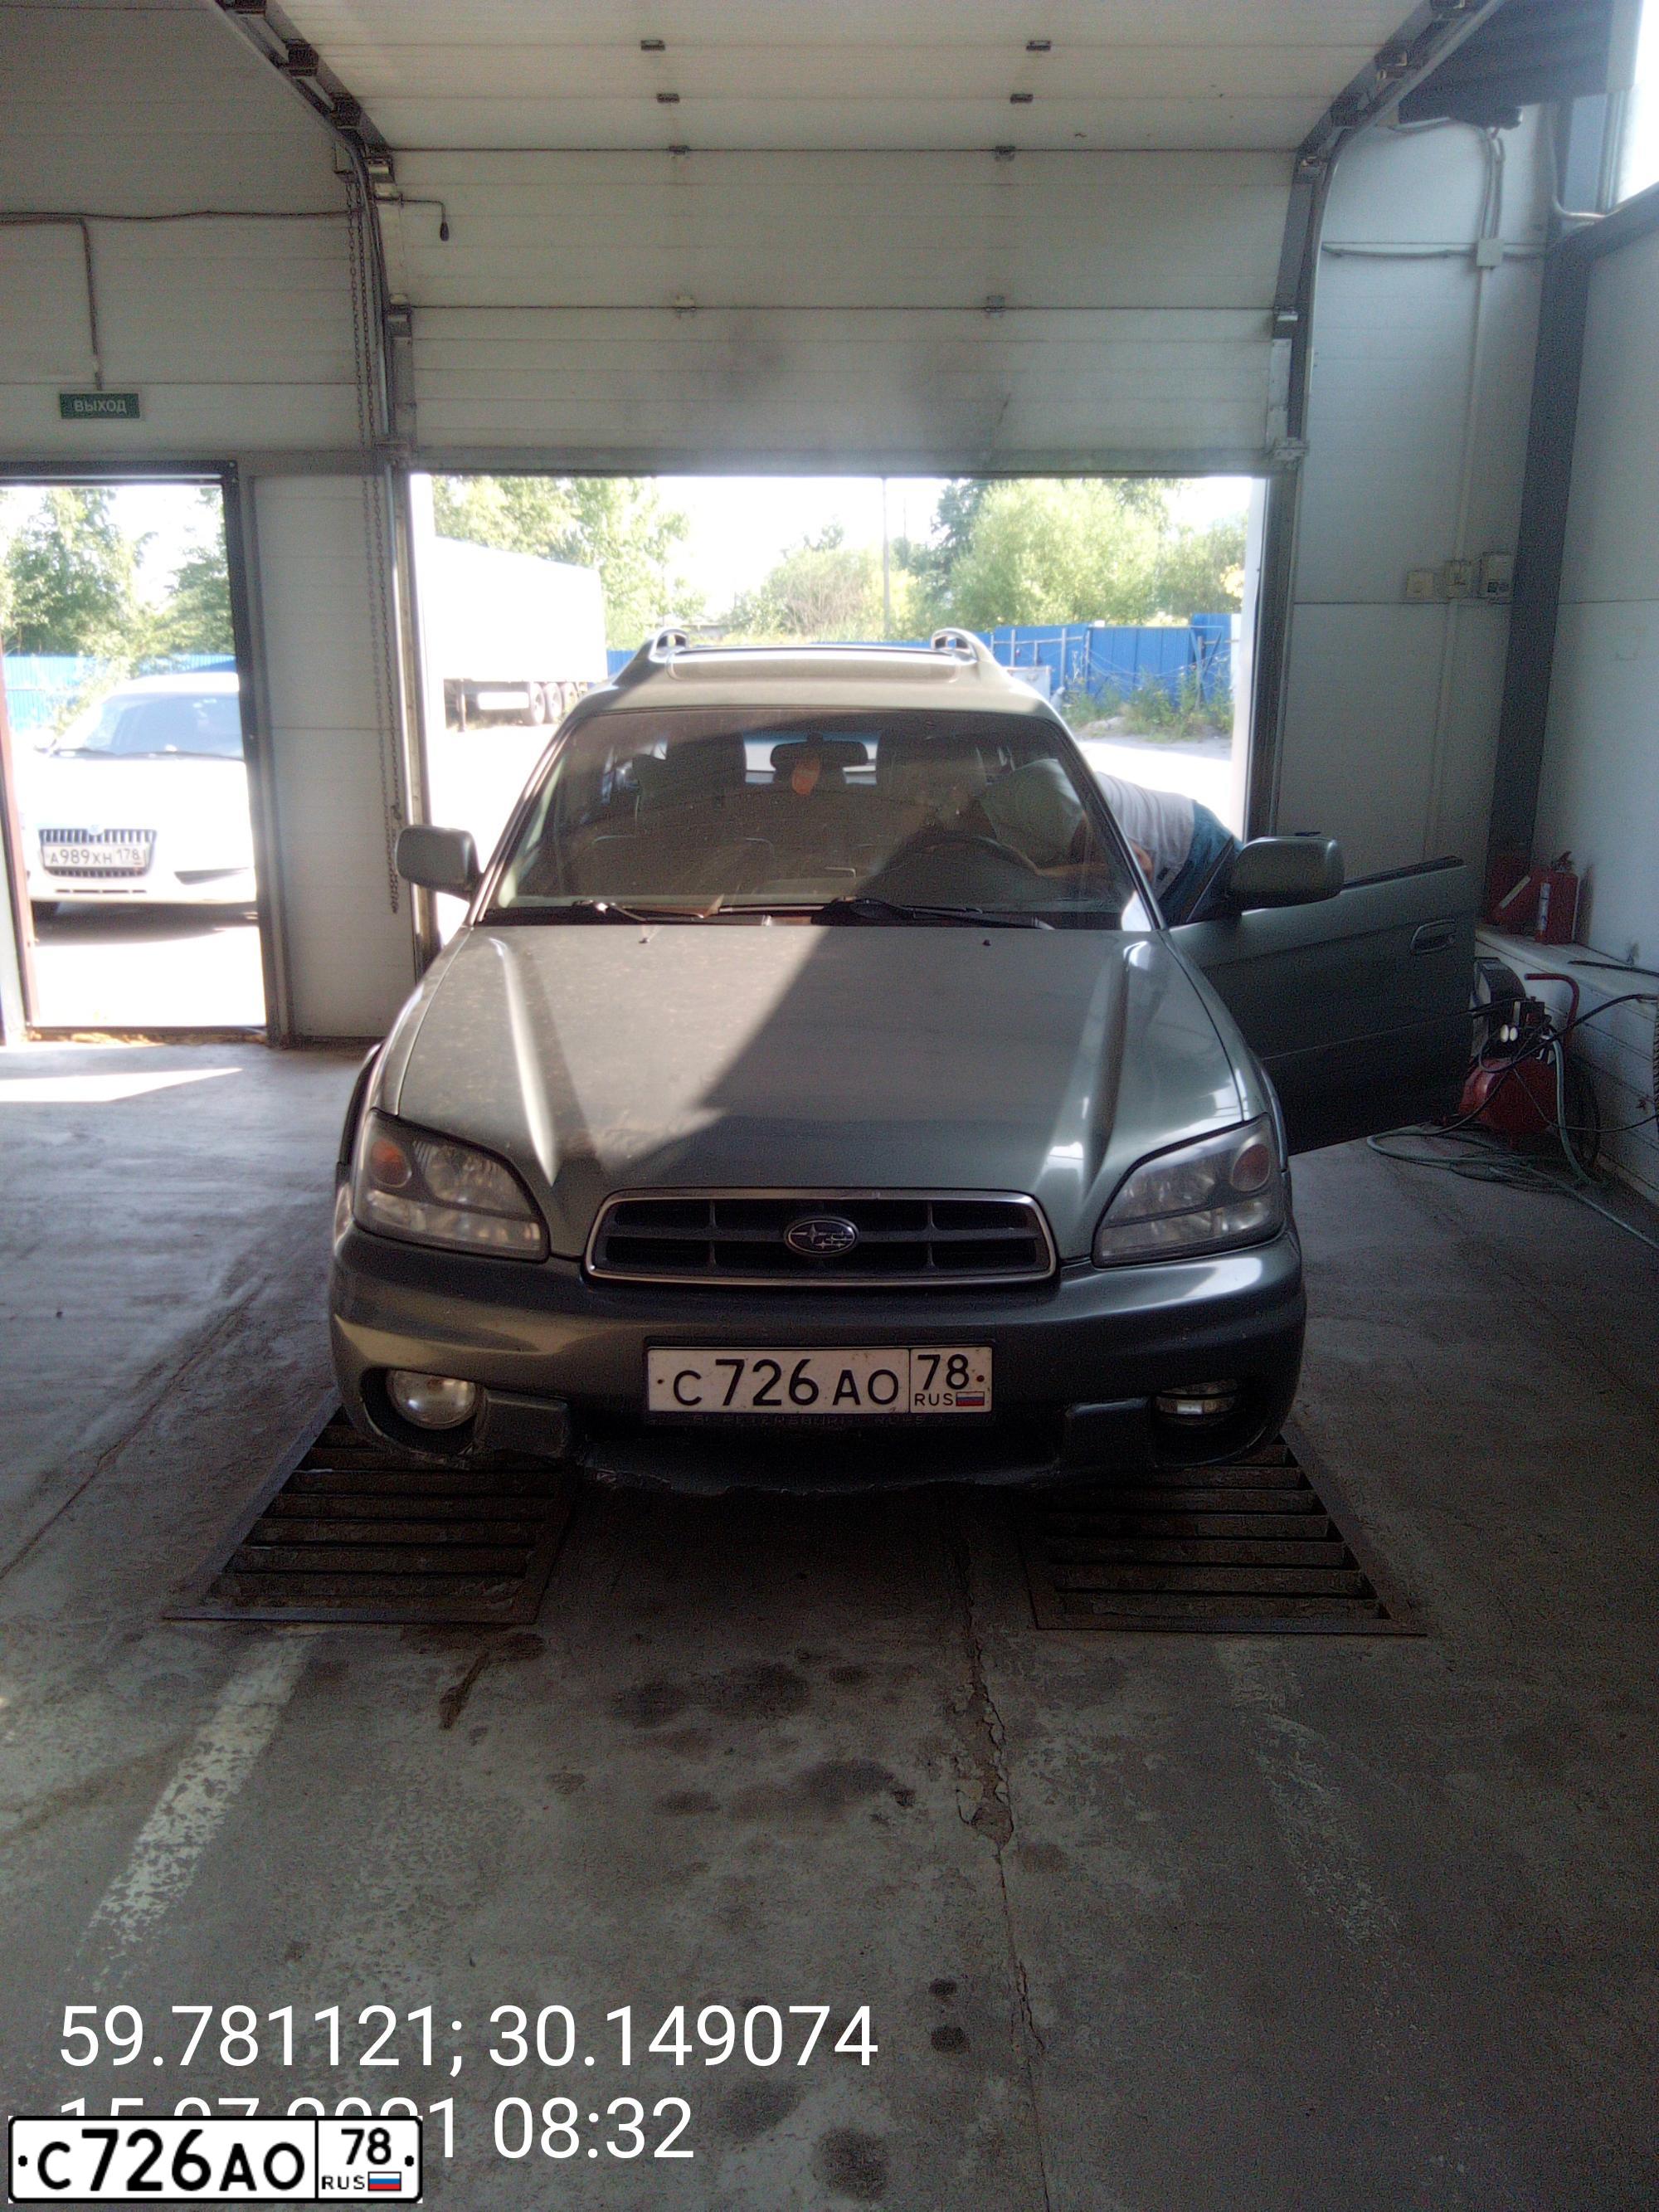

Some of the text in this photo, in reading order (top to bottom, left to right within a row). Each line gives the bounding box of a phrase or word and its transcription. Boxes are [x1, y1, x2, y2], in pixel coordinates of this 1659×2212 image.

[74, 399, 128, 414] ВЫХОД
[116, 849, 140, 860] 178
[917, 1354, 970, 1391] 78
[914, 1393, 954, 1406] RUS
